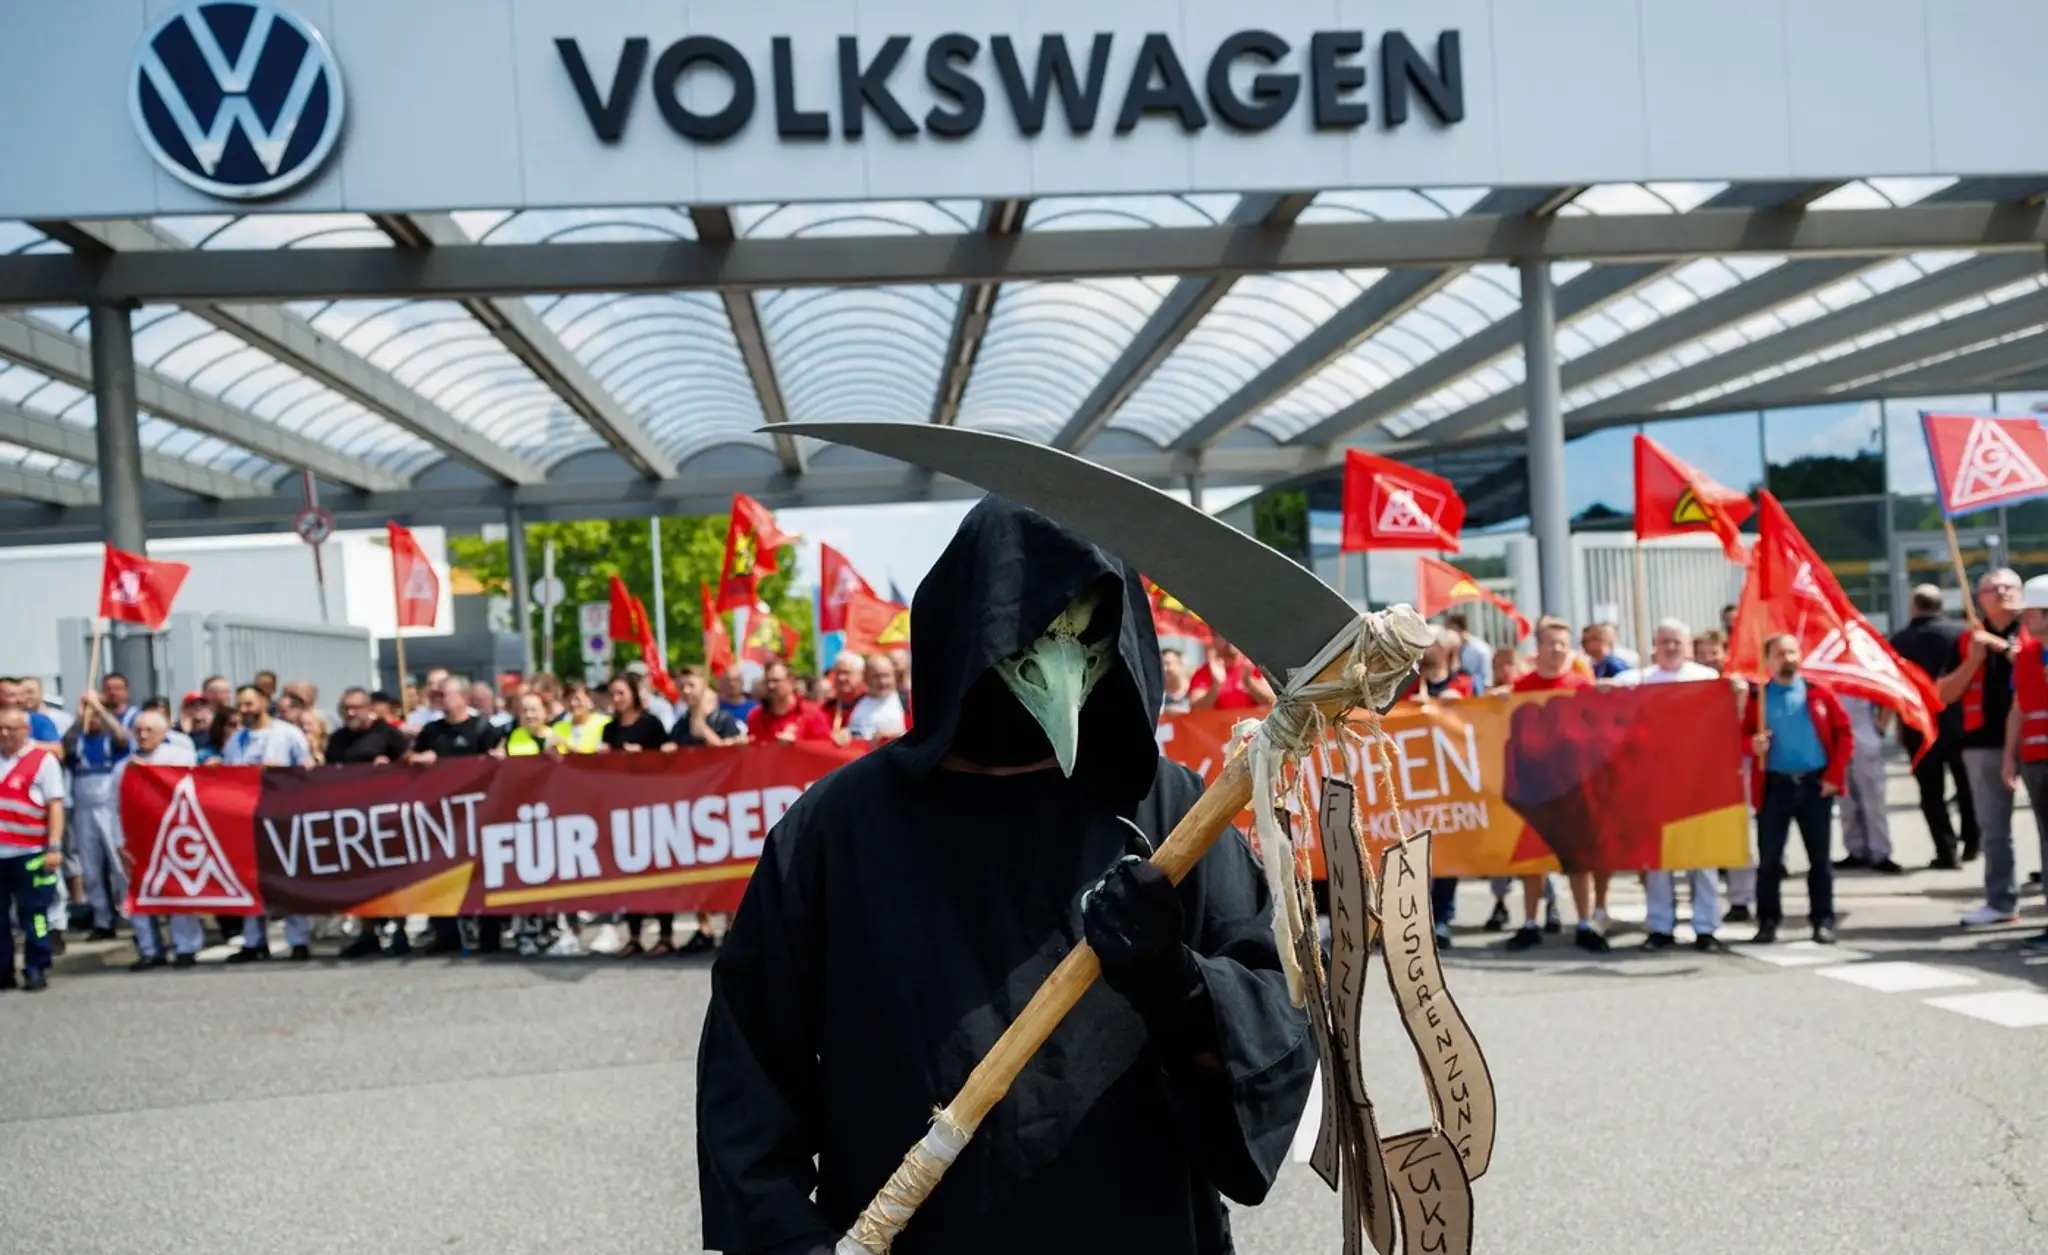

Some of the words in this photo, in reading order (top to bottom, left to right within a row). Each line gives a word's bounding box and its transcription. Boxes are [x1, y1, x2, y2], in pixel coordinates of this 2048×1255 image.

[554, 29, 1465, 146] VOLKSWAGEN
[264, 792, 487, 878] VEREINT
[481, 801, 601, 889] FÜR
